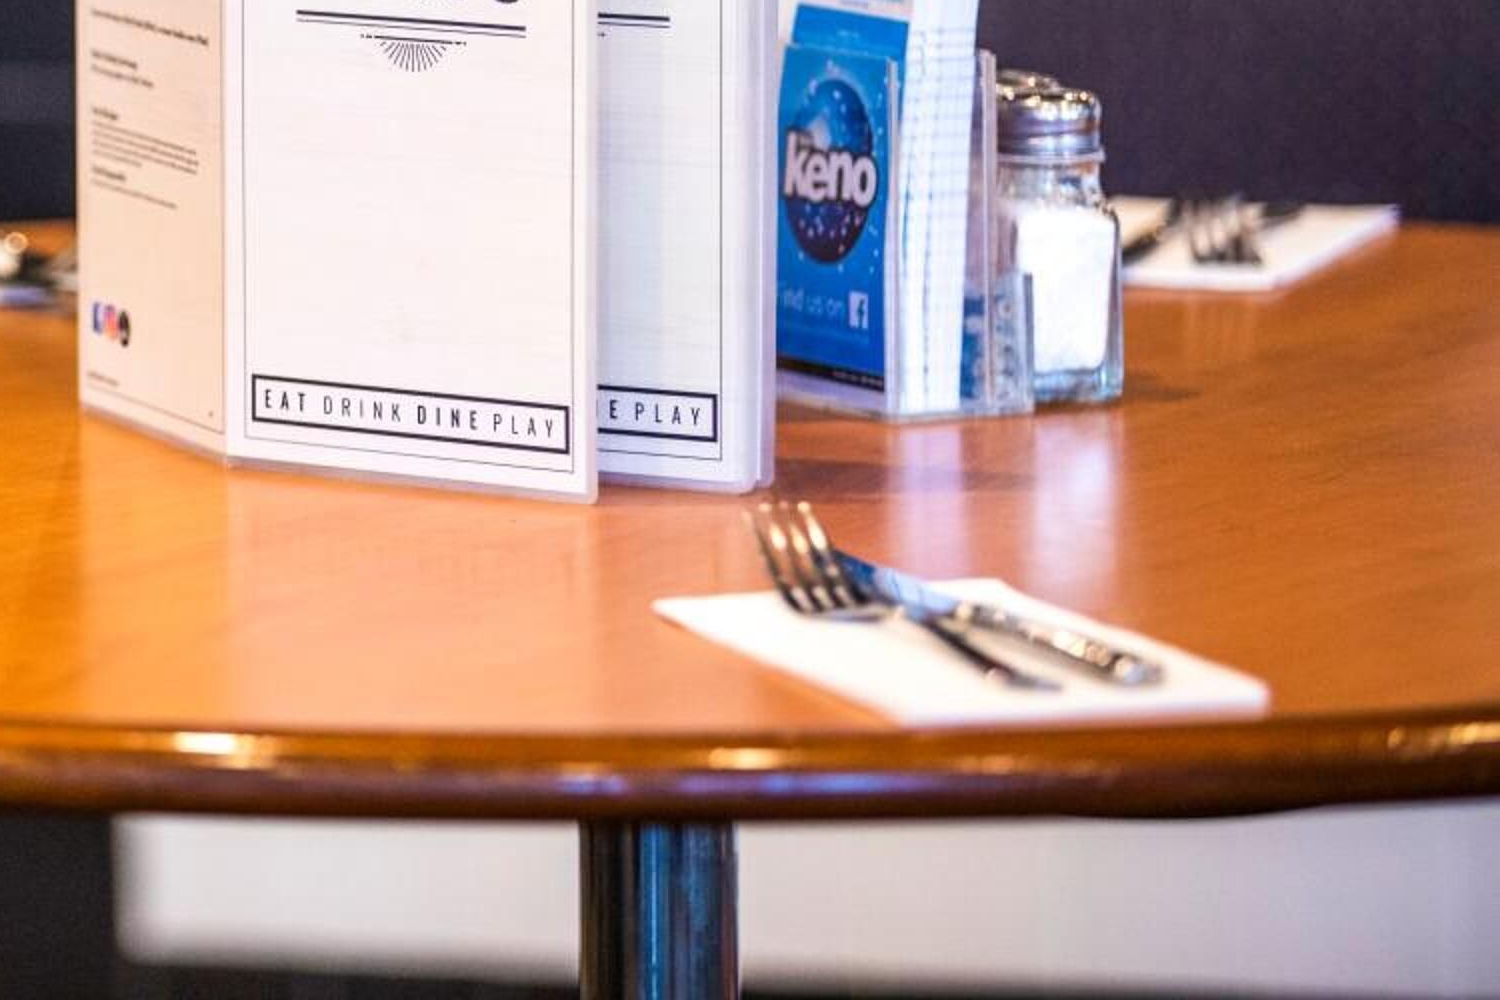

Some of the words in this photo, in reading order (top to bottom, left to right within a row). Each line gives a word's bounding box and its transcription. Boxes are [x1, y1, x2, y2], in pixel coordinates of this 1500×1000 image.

[784, 131, 877, 208] keno
[264, 388, 306, 412] EAT
[323, 395, 402, 423] DRINK
[417, 404, 478, 431] DINE
[493, 413, 553, 439] PLAY
[635, 402, 701, 426] PLAY
